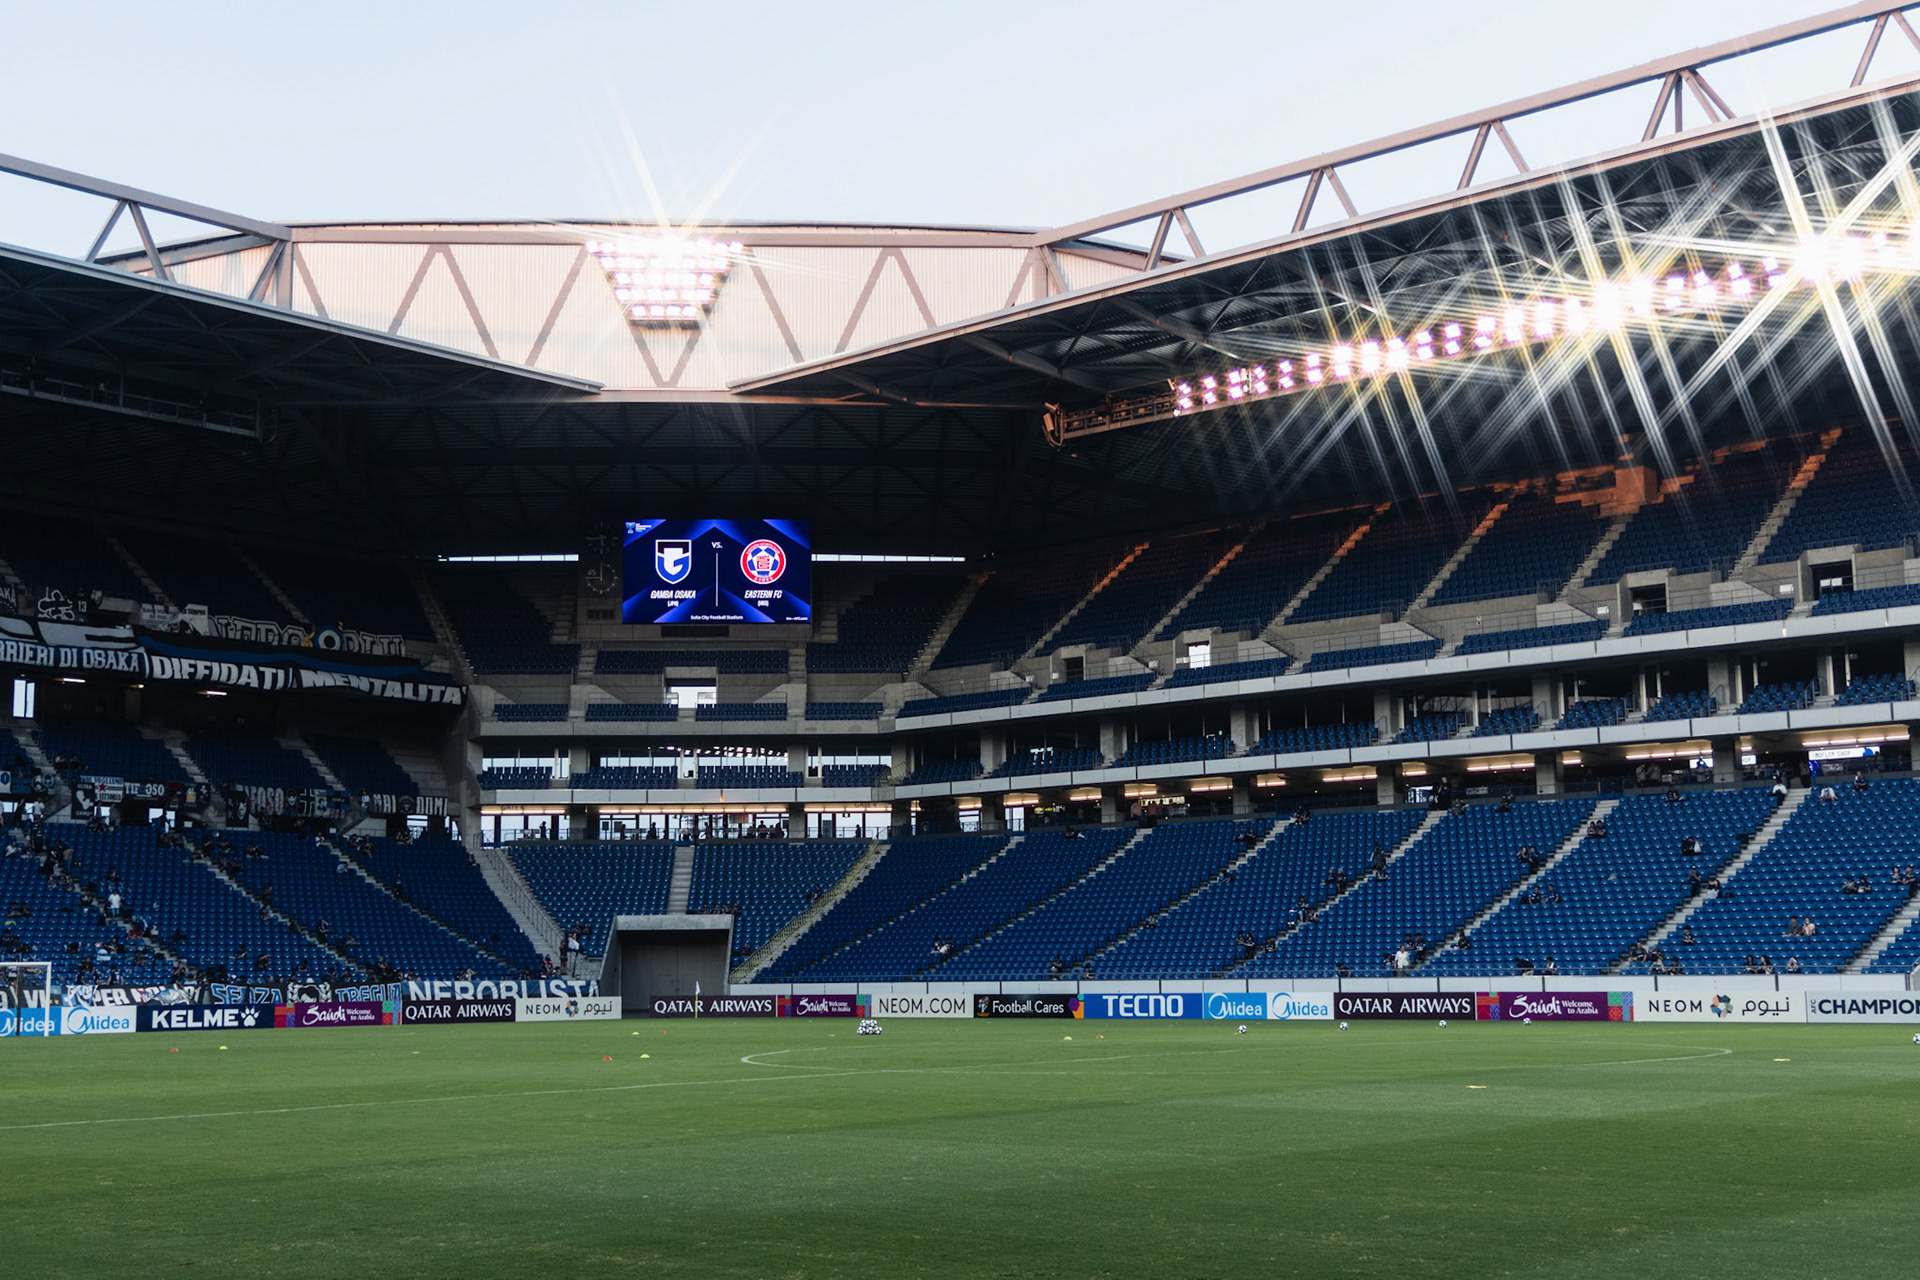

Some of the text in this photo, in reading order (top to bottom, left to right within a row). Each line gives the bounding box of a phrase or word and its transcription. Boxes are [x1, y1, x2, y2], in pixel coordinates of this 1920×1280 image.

[650, 590, 696, 598] GAMBA OSAKA
[744, 590, 782, 598] EASTERN FC
[58, 648, 78, 669] DI
[82, 649, 140, 673] OSAKA
[150, 654, 467, 706] DIFFIDATI MENTALITA'
[405, 1003, 512, 1020] QATAR AIRWAYS
[526, 1004, 561, 1014] NEOM
[584, 1001, 612, 1016] نيوم
[654, 1000, 772, 1014] QATAR AIRWAYS
[878, 998, 966, 1014] NEOM.COM
[992, 1000, 1064, 1014] Football Cares
[1102, 995, 1184, 1018] TECNO
[1218, 1002, 1262, 1016] Midea
[1280, 1002, 1328, 1016] Midea
[1338, 998, 1470, 1014] QATAR AIRWAYS
[1648, 1000, 1702, 1013] NEOM
[1742, 997, 1790, 1016] نيوم
[79, 1016, 130, 1030] Midea
[152, 1008, 240, 1028] KELME
